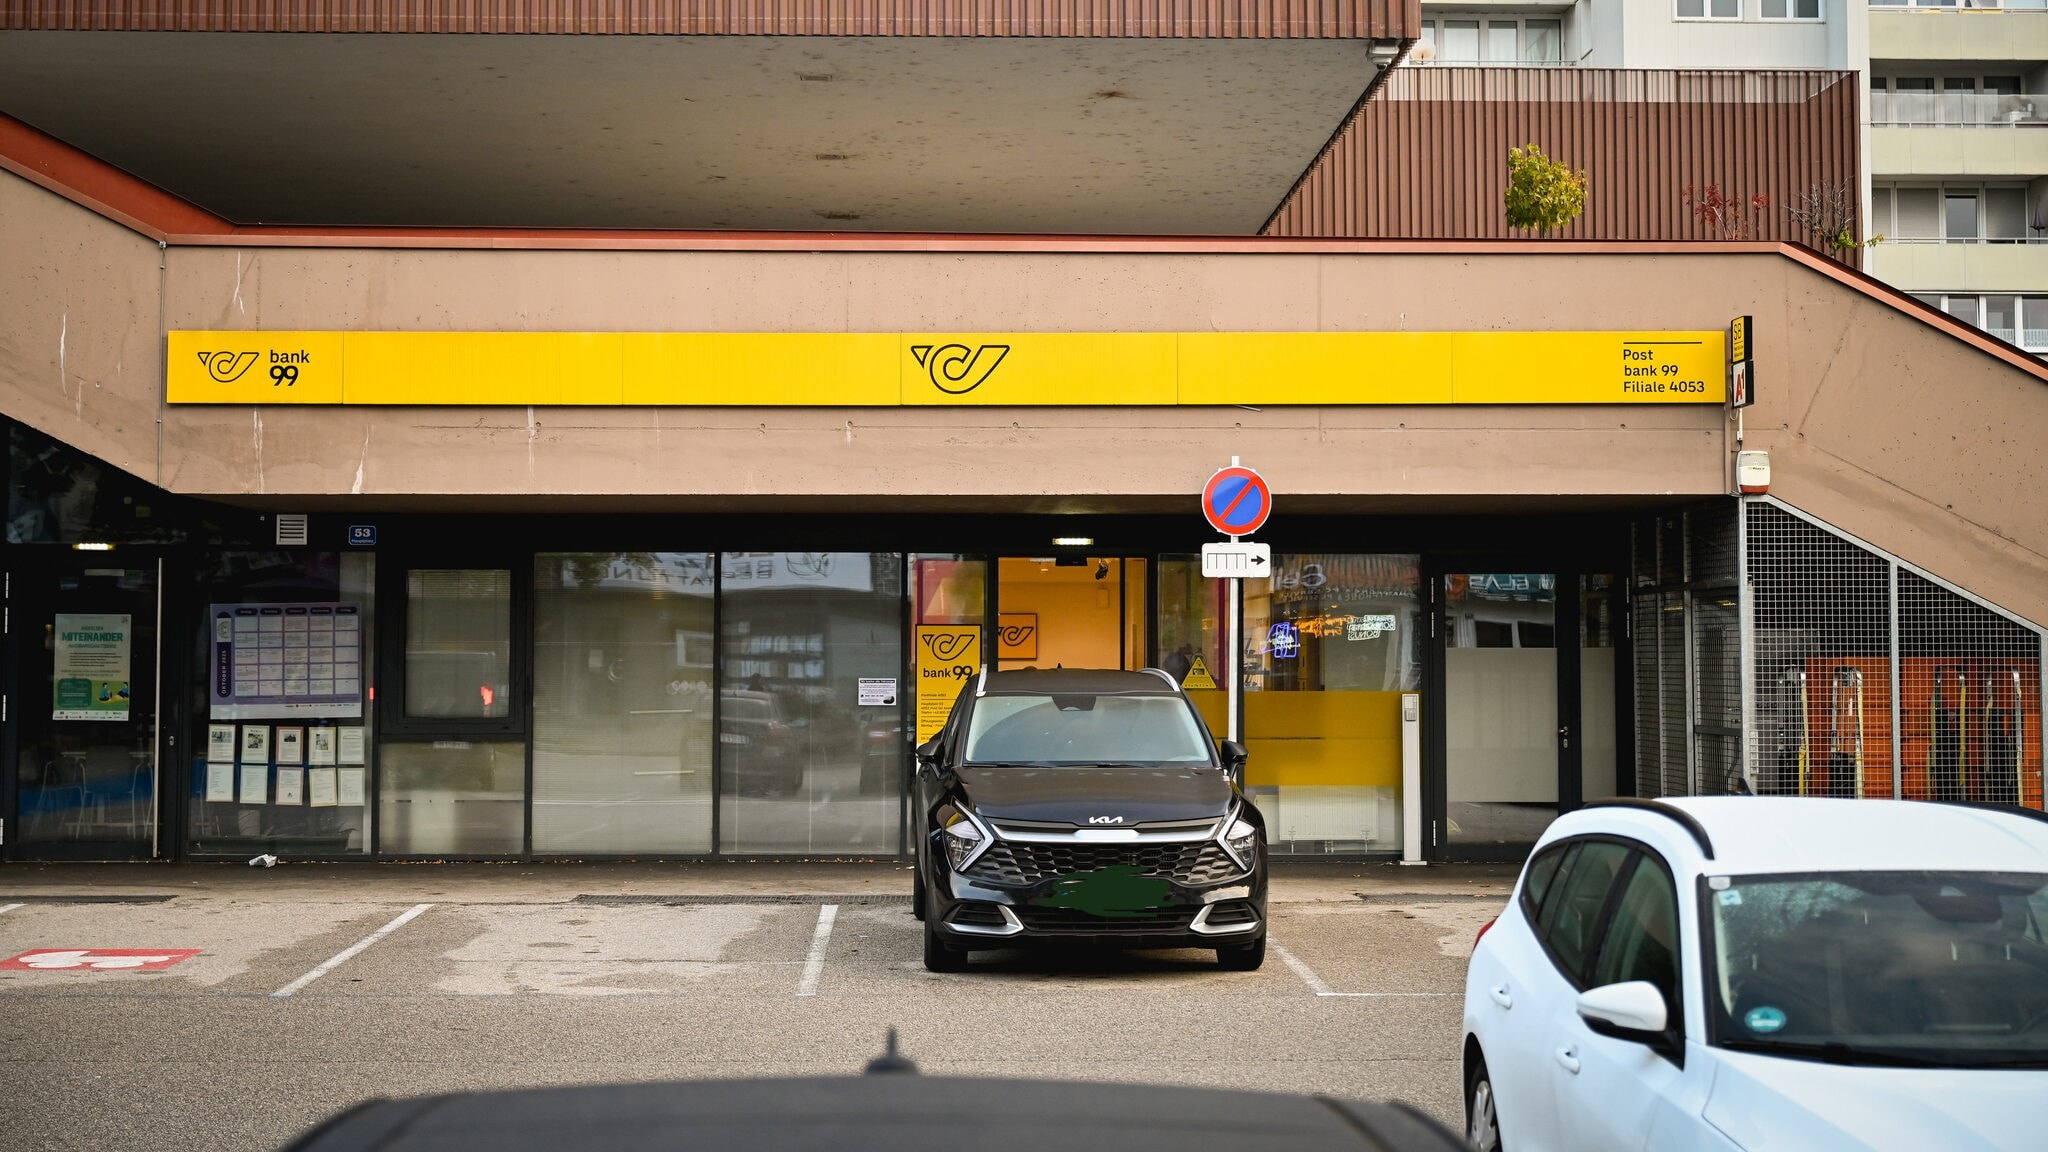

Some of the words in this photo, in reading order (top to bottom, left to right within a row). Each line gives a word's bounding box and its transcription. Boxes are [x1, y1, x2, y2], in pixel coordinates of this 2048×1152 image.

[1733, 323, 1742, 340] SB
[270, 349, 310, 363] bank
[1623, 349, 1653, 361] Post
[270, 365, 299, 386] 99
[1624, 365, 1657, 376] bank
[1661, 365, 1679, 376] 99
[1623, 381, 1665, 392] Filiale
[1669, 381, 1705, 392] 4053
[1735, 368, 1745, 403] A1
[354, 528, 371, 538] 53
[62, 632, 123, 642] MITEINANDER
[923, 667, 951, 678] bank
[953, 665, 973, 680] 99
